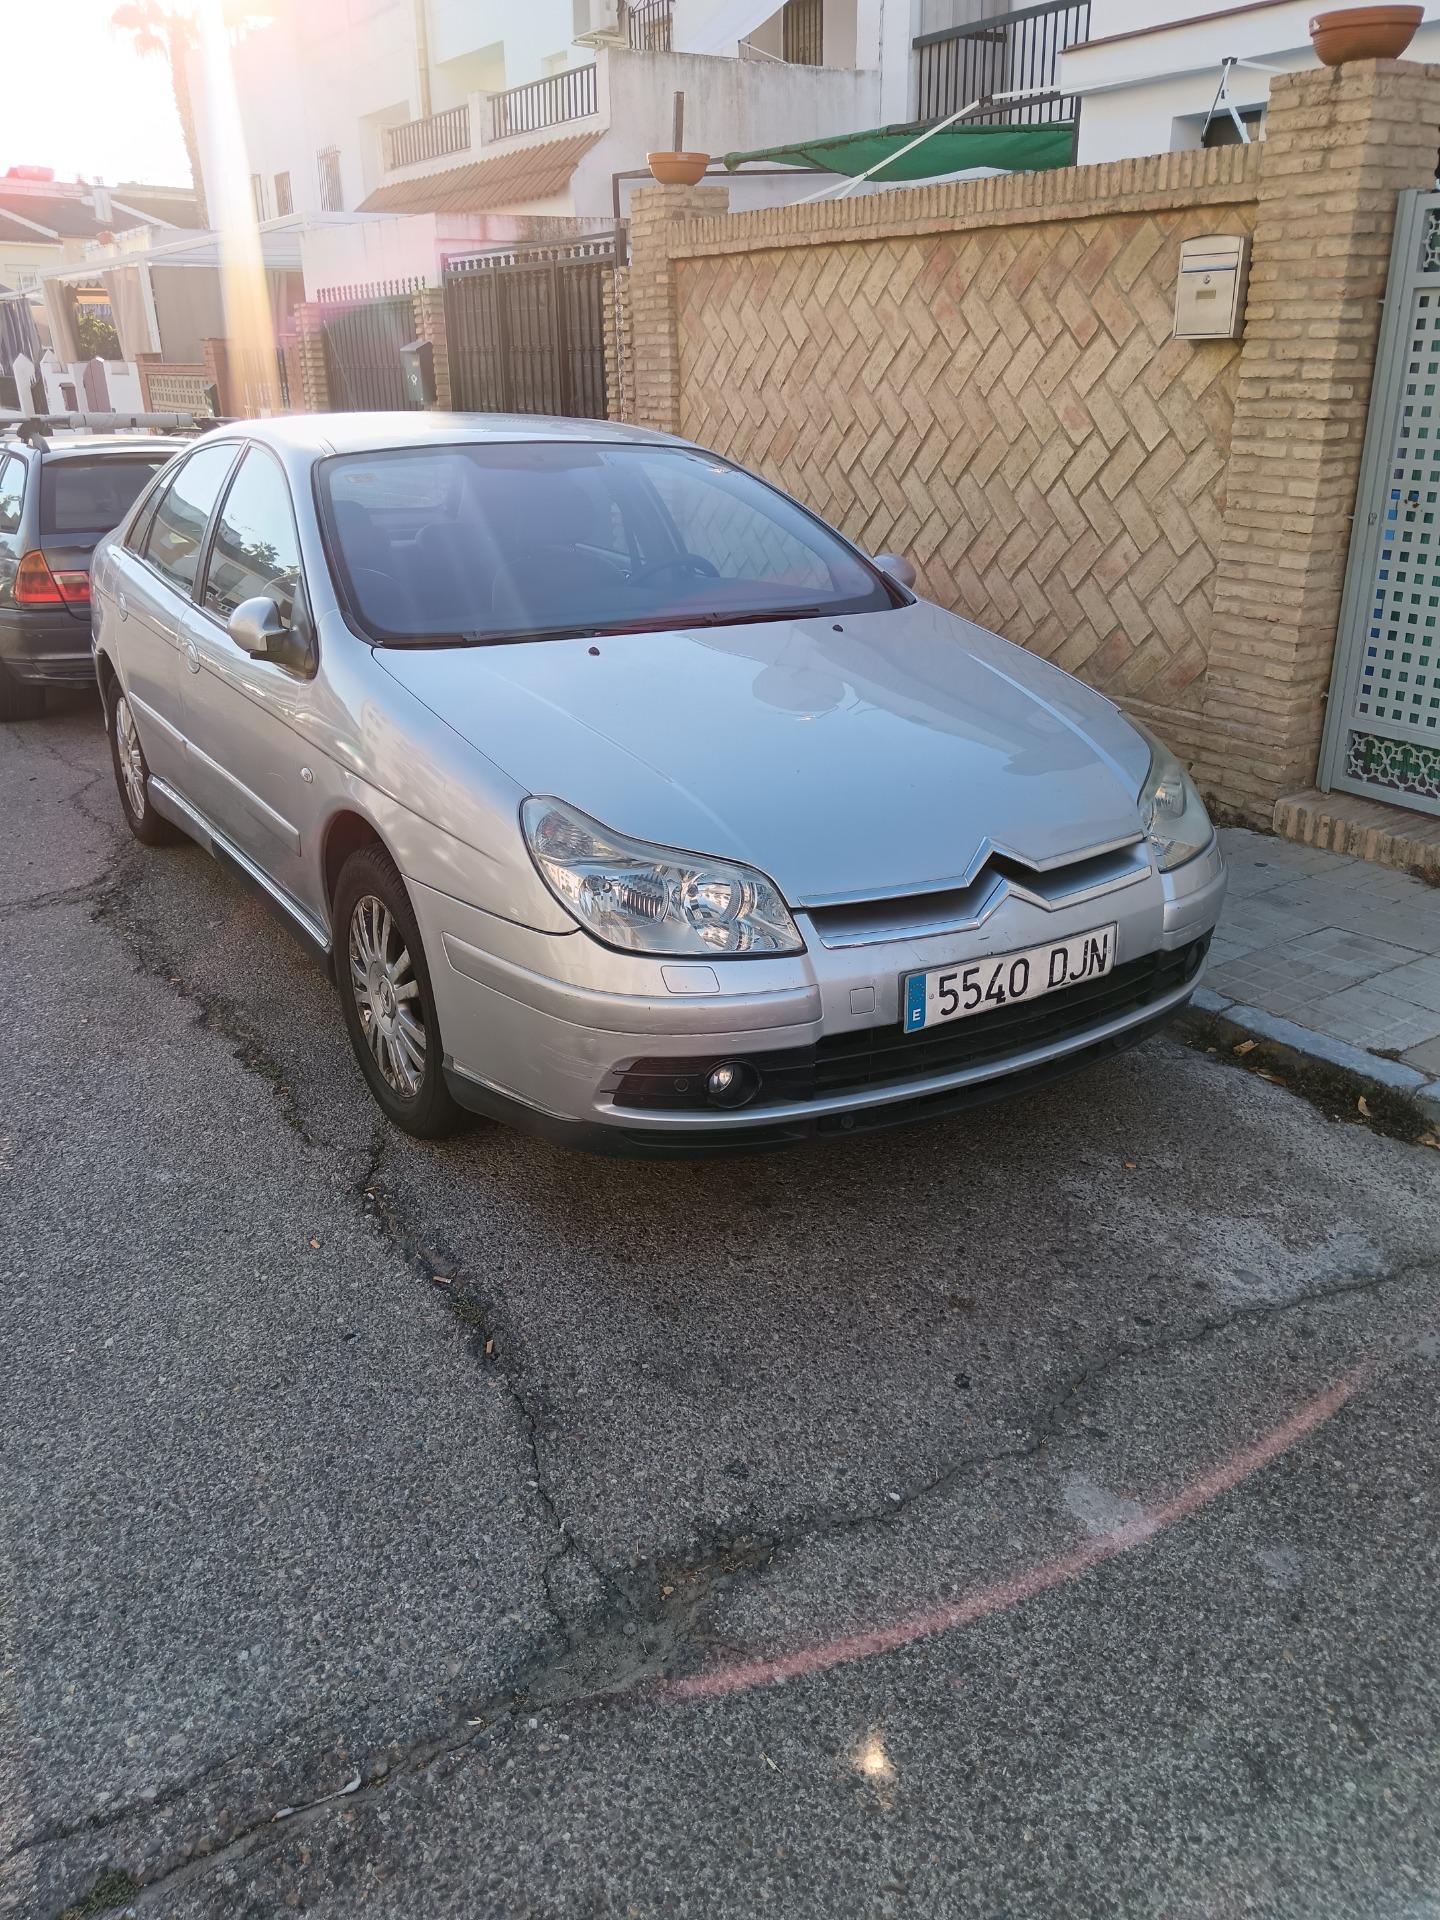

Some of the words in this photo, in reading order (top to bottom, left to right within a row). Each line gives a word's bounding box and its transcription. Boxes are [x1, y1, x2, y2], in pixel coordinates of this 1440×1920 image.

[938, 957, 1030, 1016] 5540
[1046, 934, 1108, 989] DJN
[912, 1008, 921, 1021] E
